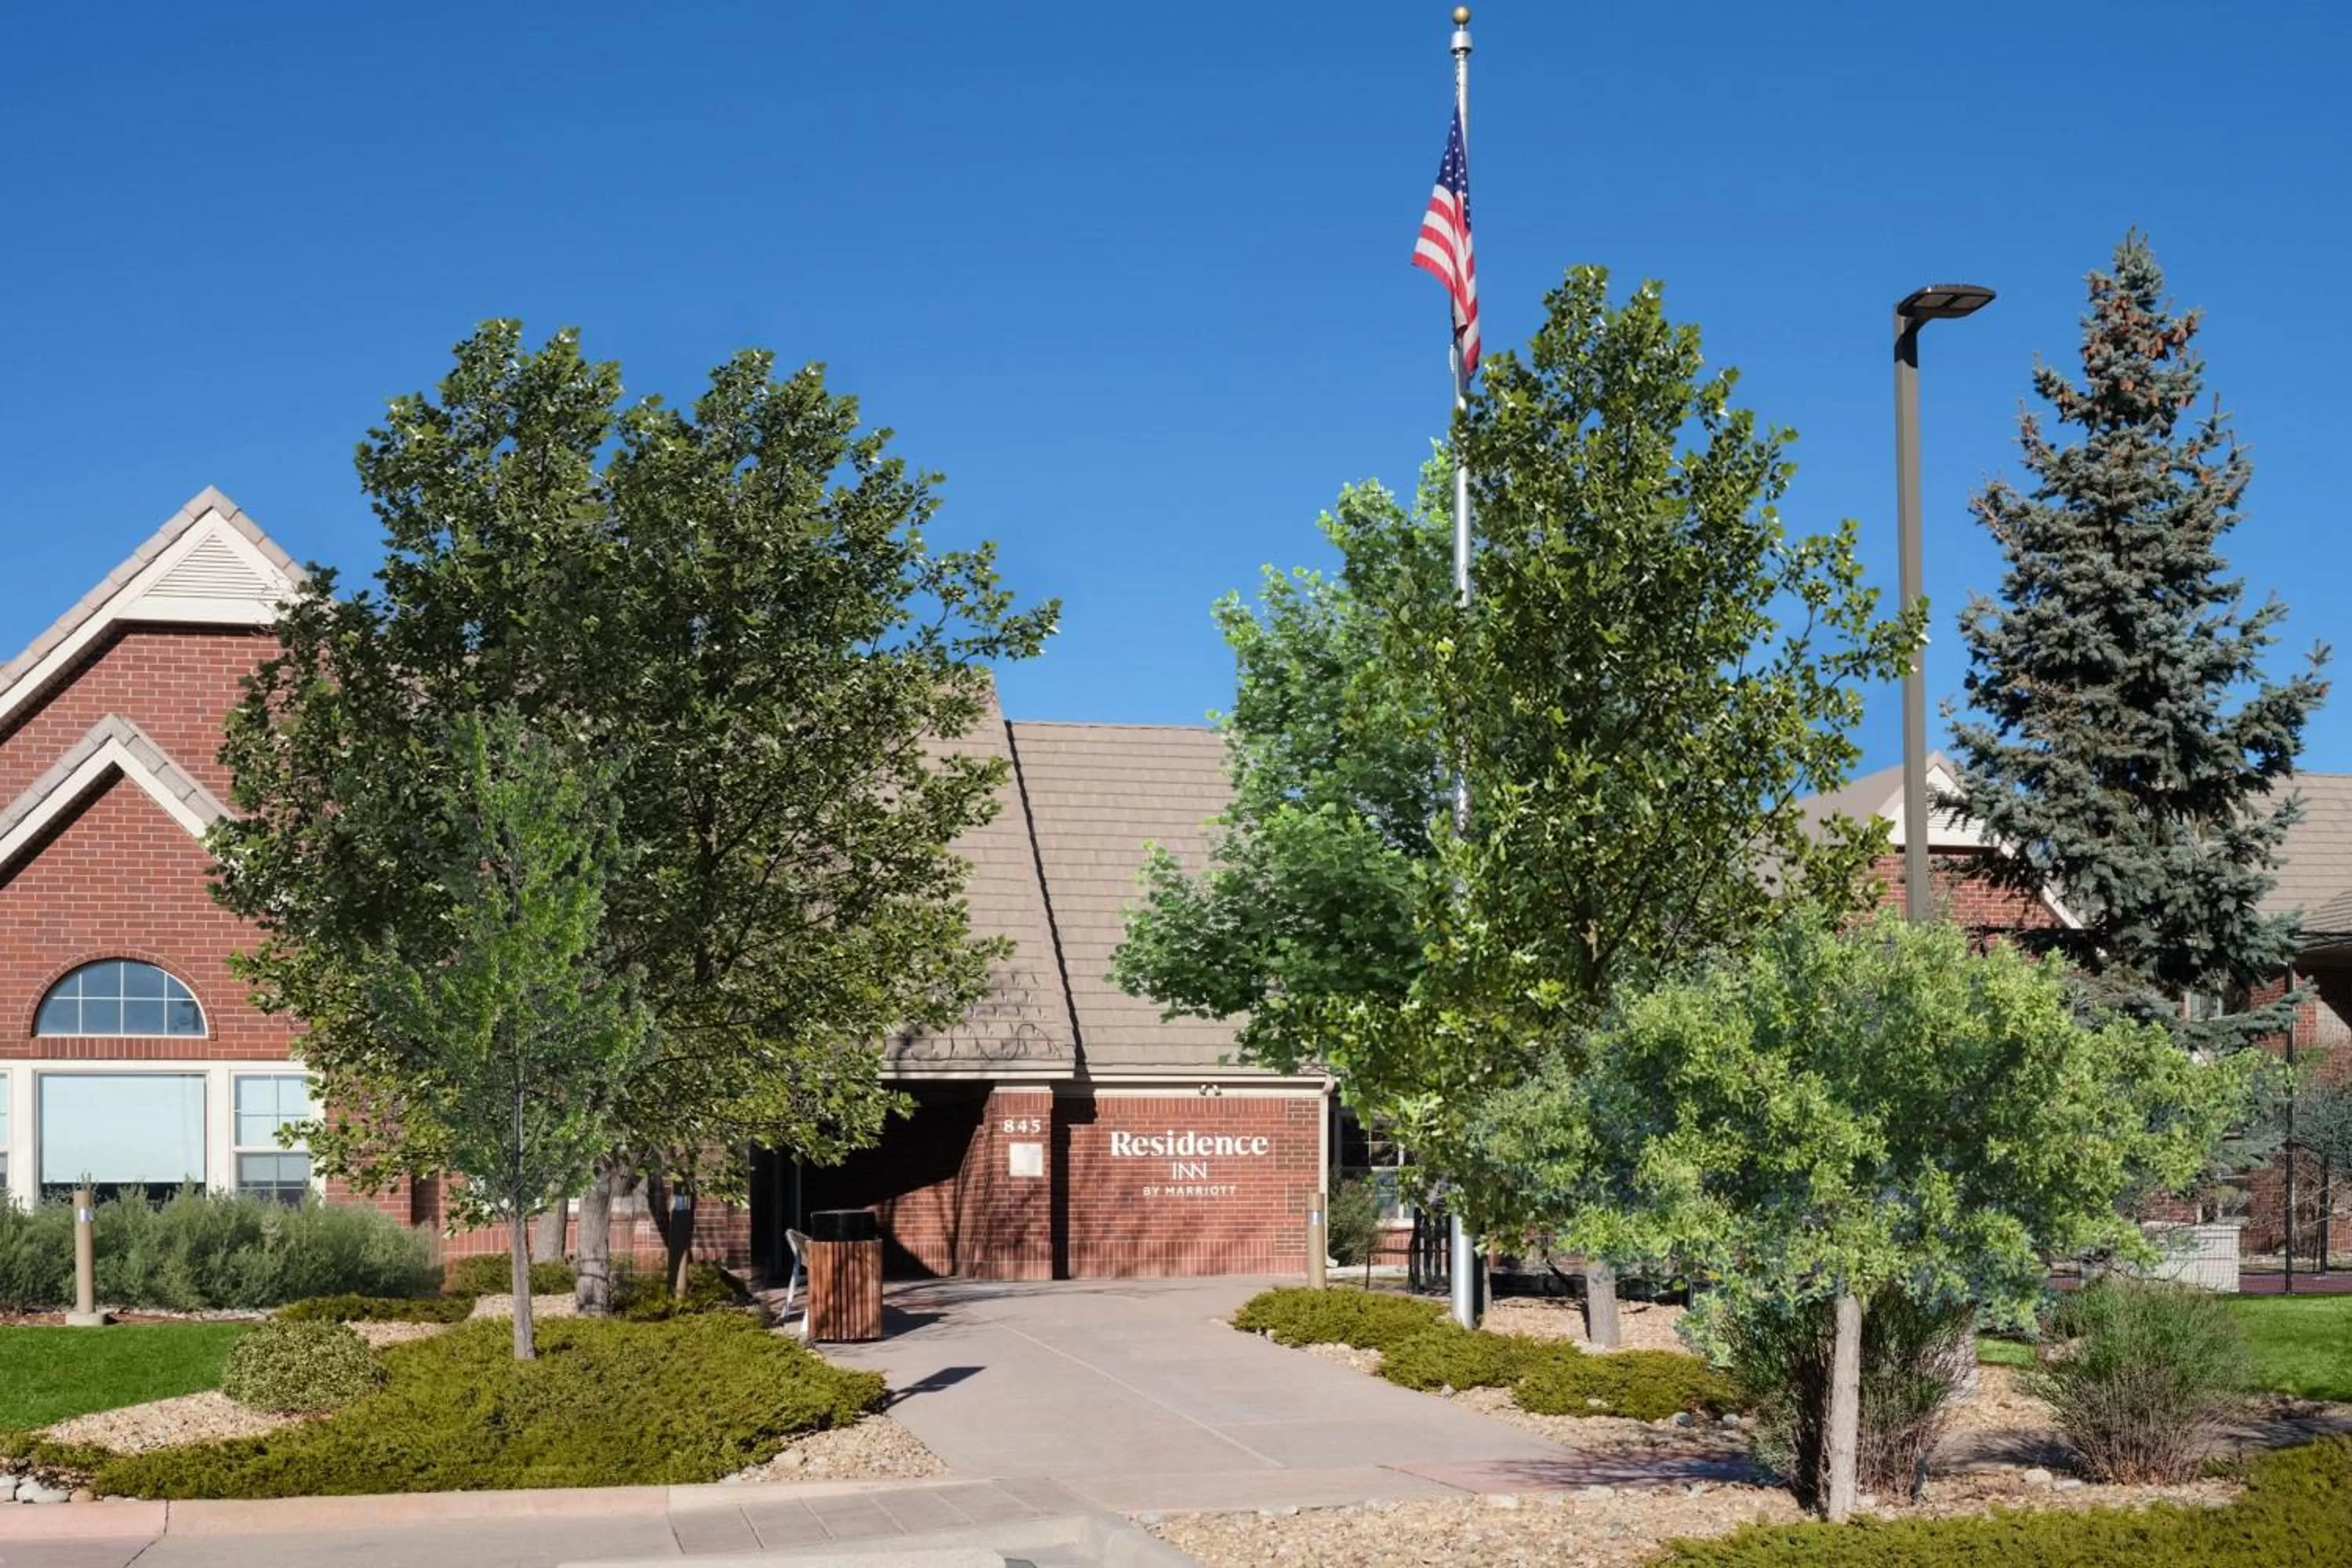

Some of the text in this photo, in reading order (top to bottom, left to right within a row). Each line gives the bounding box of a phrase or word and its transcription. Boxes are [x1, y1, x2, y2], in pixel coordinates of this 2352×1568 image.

[1004, 1119, 1042, 1133] 845
[1109, 1130, 1269, 1156] Residence
[1172, 1162, 1207, 1180] INN
[1143, 1185, 1236, 1196] BY MARRIOTT
